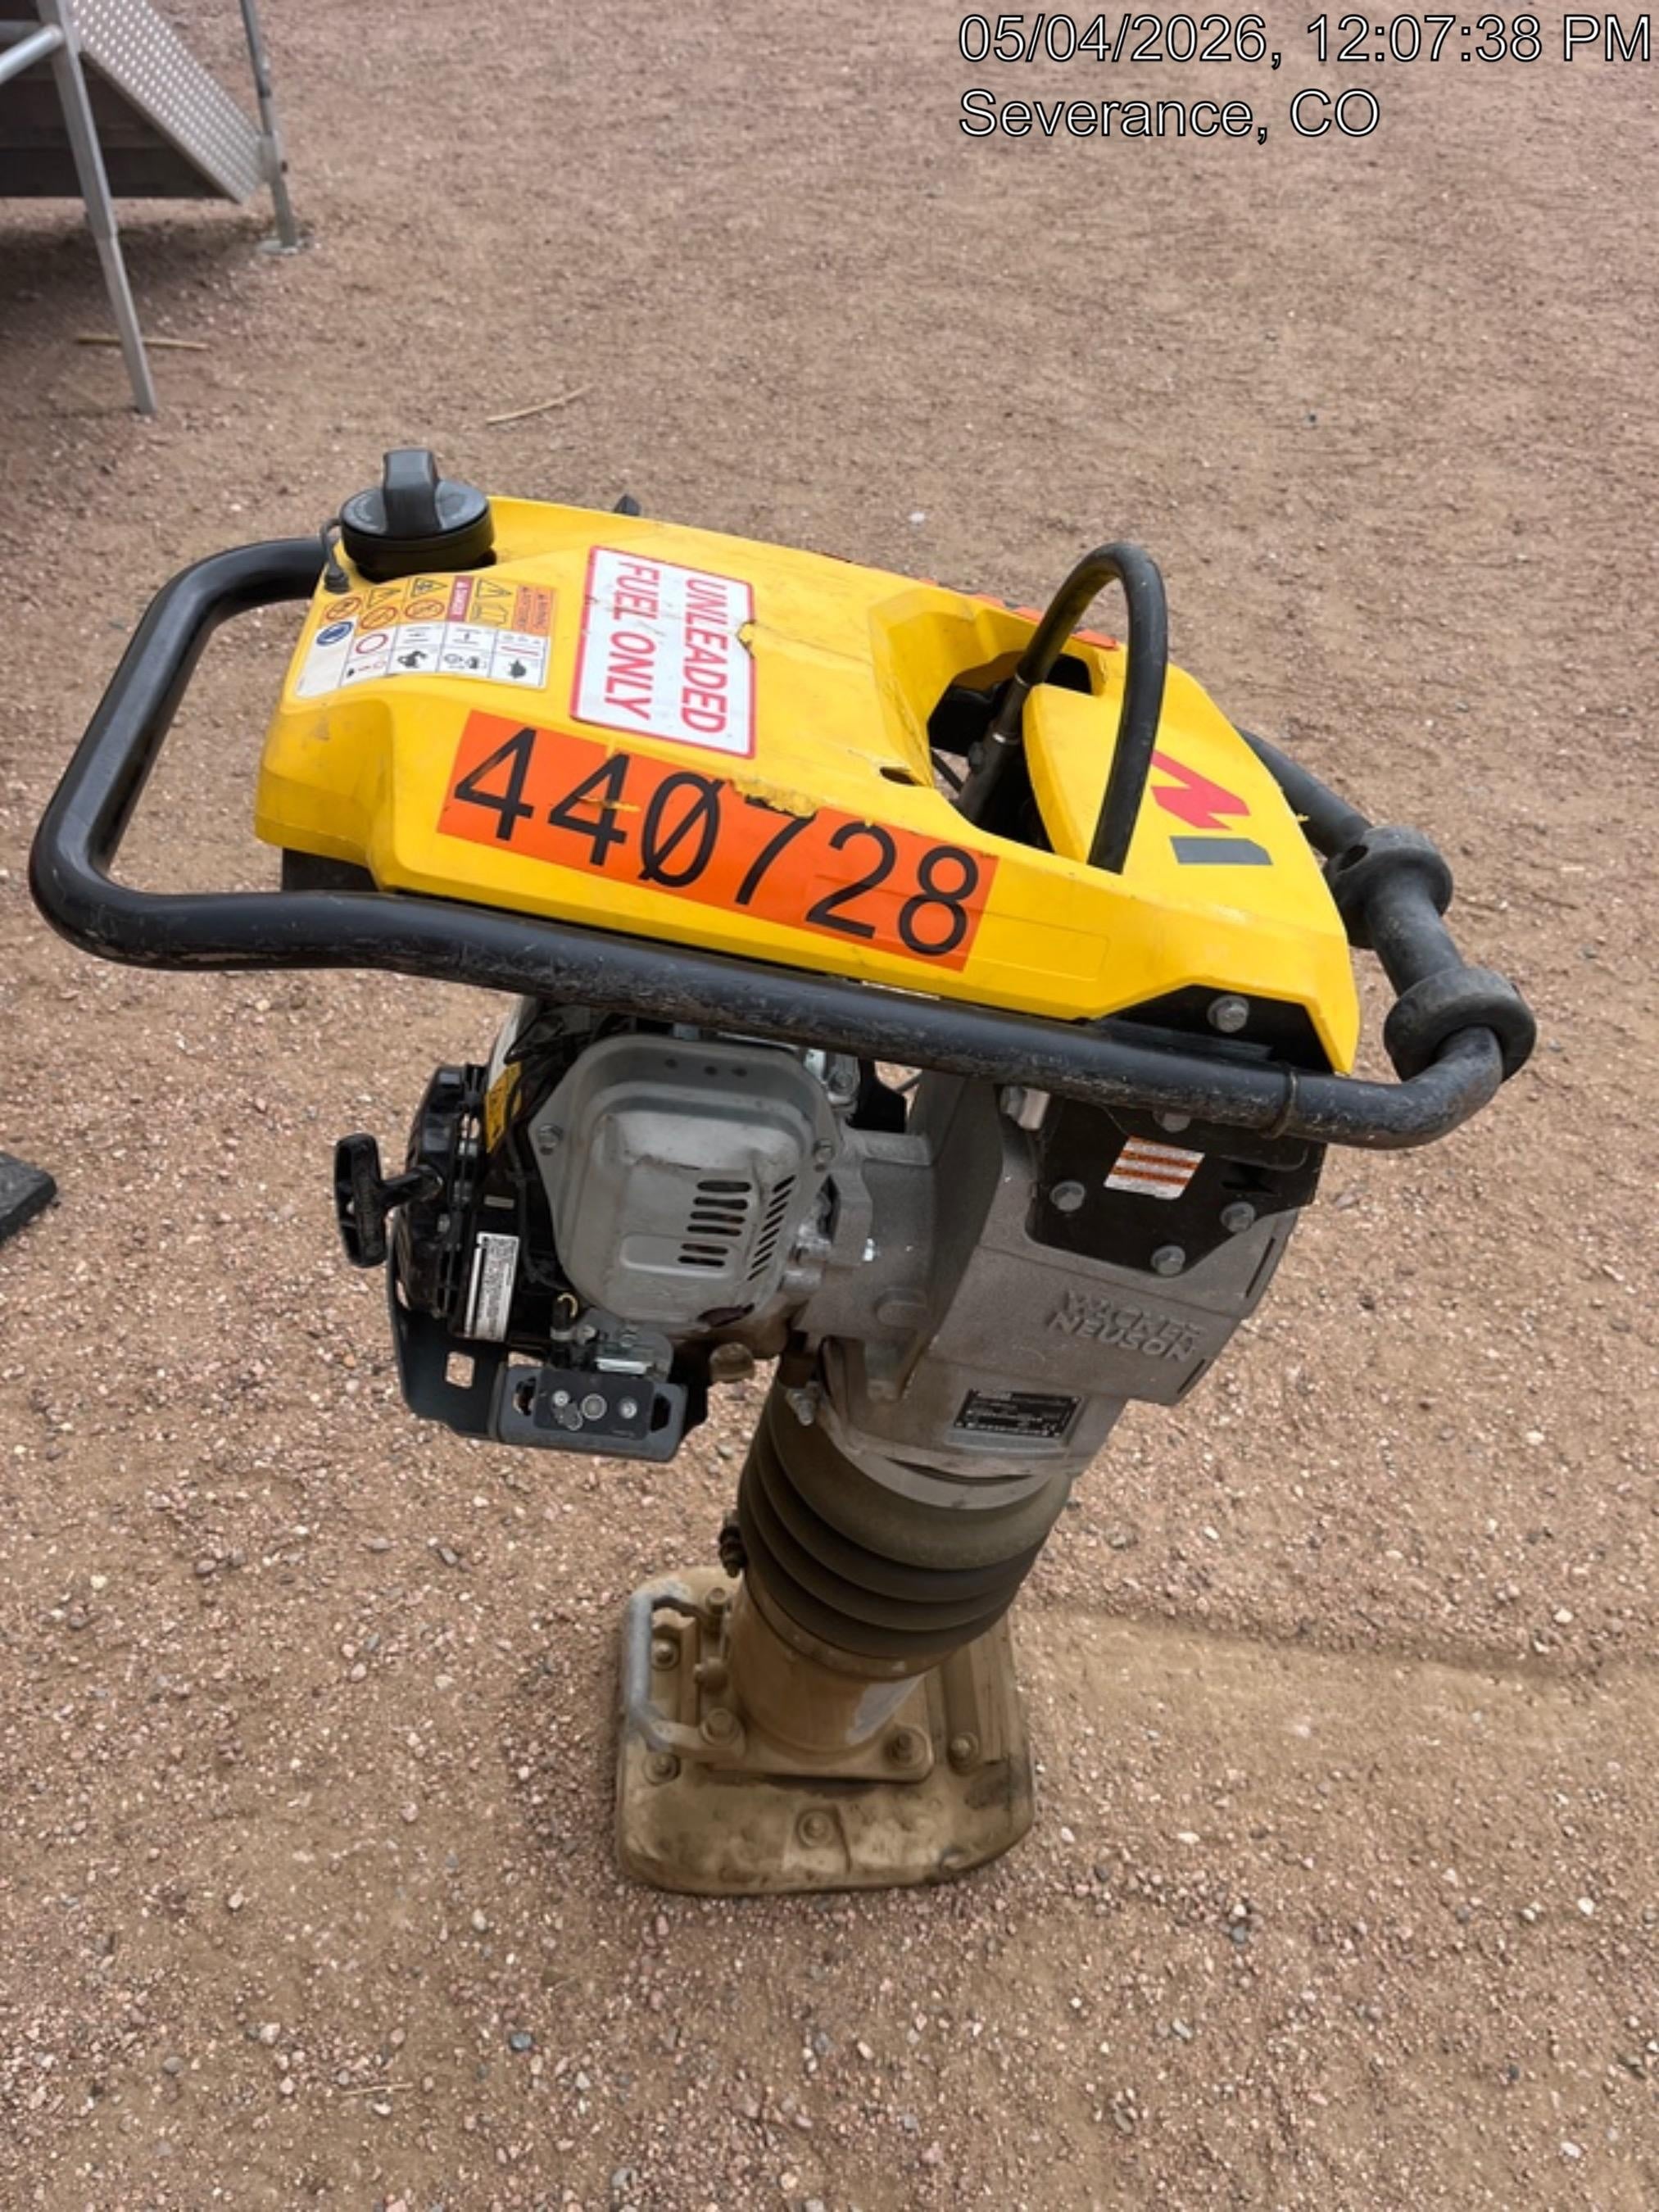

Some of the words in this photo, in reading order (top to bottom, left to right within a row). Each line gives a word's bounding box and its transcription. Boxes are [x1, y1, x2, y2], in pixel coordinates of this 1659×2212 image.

[613, 561, 660, 620] FUEL
[605, 631, 657, 721] ONLY
[681, 577, 728, 734] UNLEADED
[454, 726, 979, 957] 440728
[1045, 1310, 1197, 1362] NEUSON
